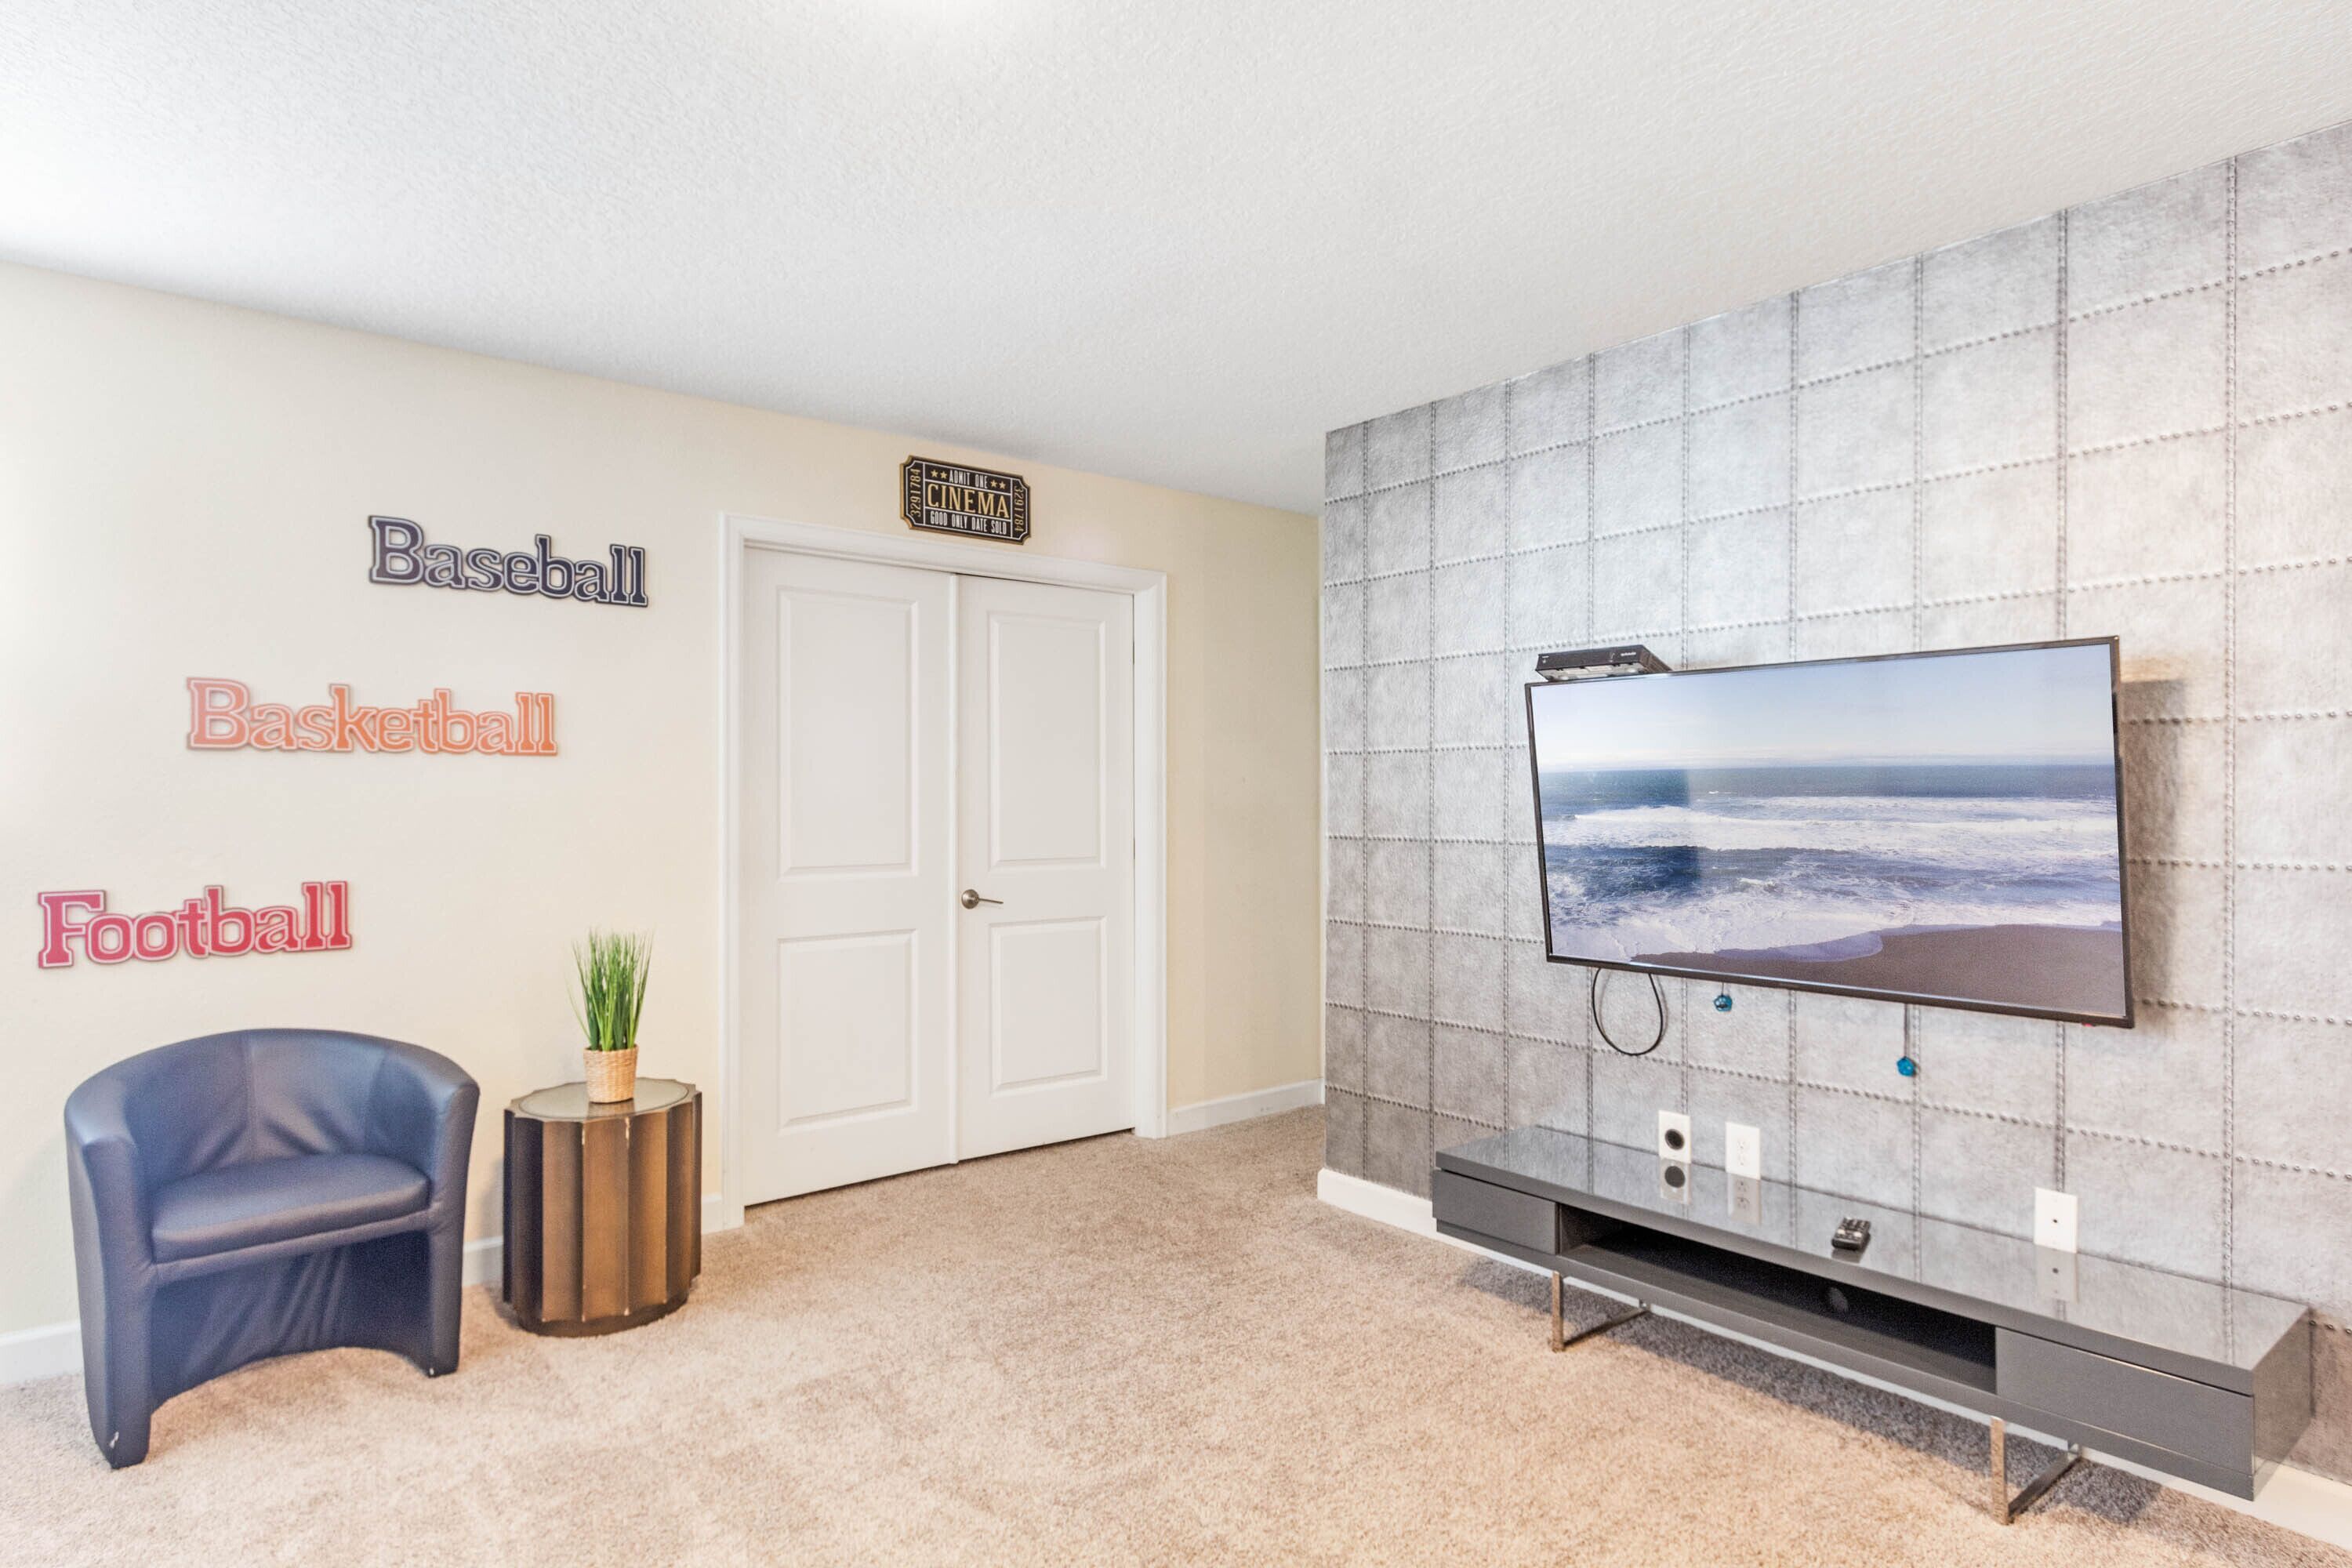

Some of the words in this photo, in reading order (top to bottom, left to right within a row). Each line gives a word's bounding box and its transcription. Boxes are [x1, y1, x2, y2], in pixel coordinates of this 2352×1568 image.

[910, 469, 921, 517] 3291784
[927, 483, 1010, 518] CINEMA
[949, 470, 971, 486] ADMIT
[975, 474, 988, 489] ONE
[930, 510, 948, 526] GOOD
[951, 514, 968, 529] ONLY
[971, 517, 988, 532] DATE
[991, 520, 1007, 535] SOLD
[1014, 485, 1024, 532] 3291784
[368, 515, 648, 607] Baseball
[186, 677, 558, 757] Basketball
[38, 880, 353, 968] Football
